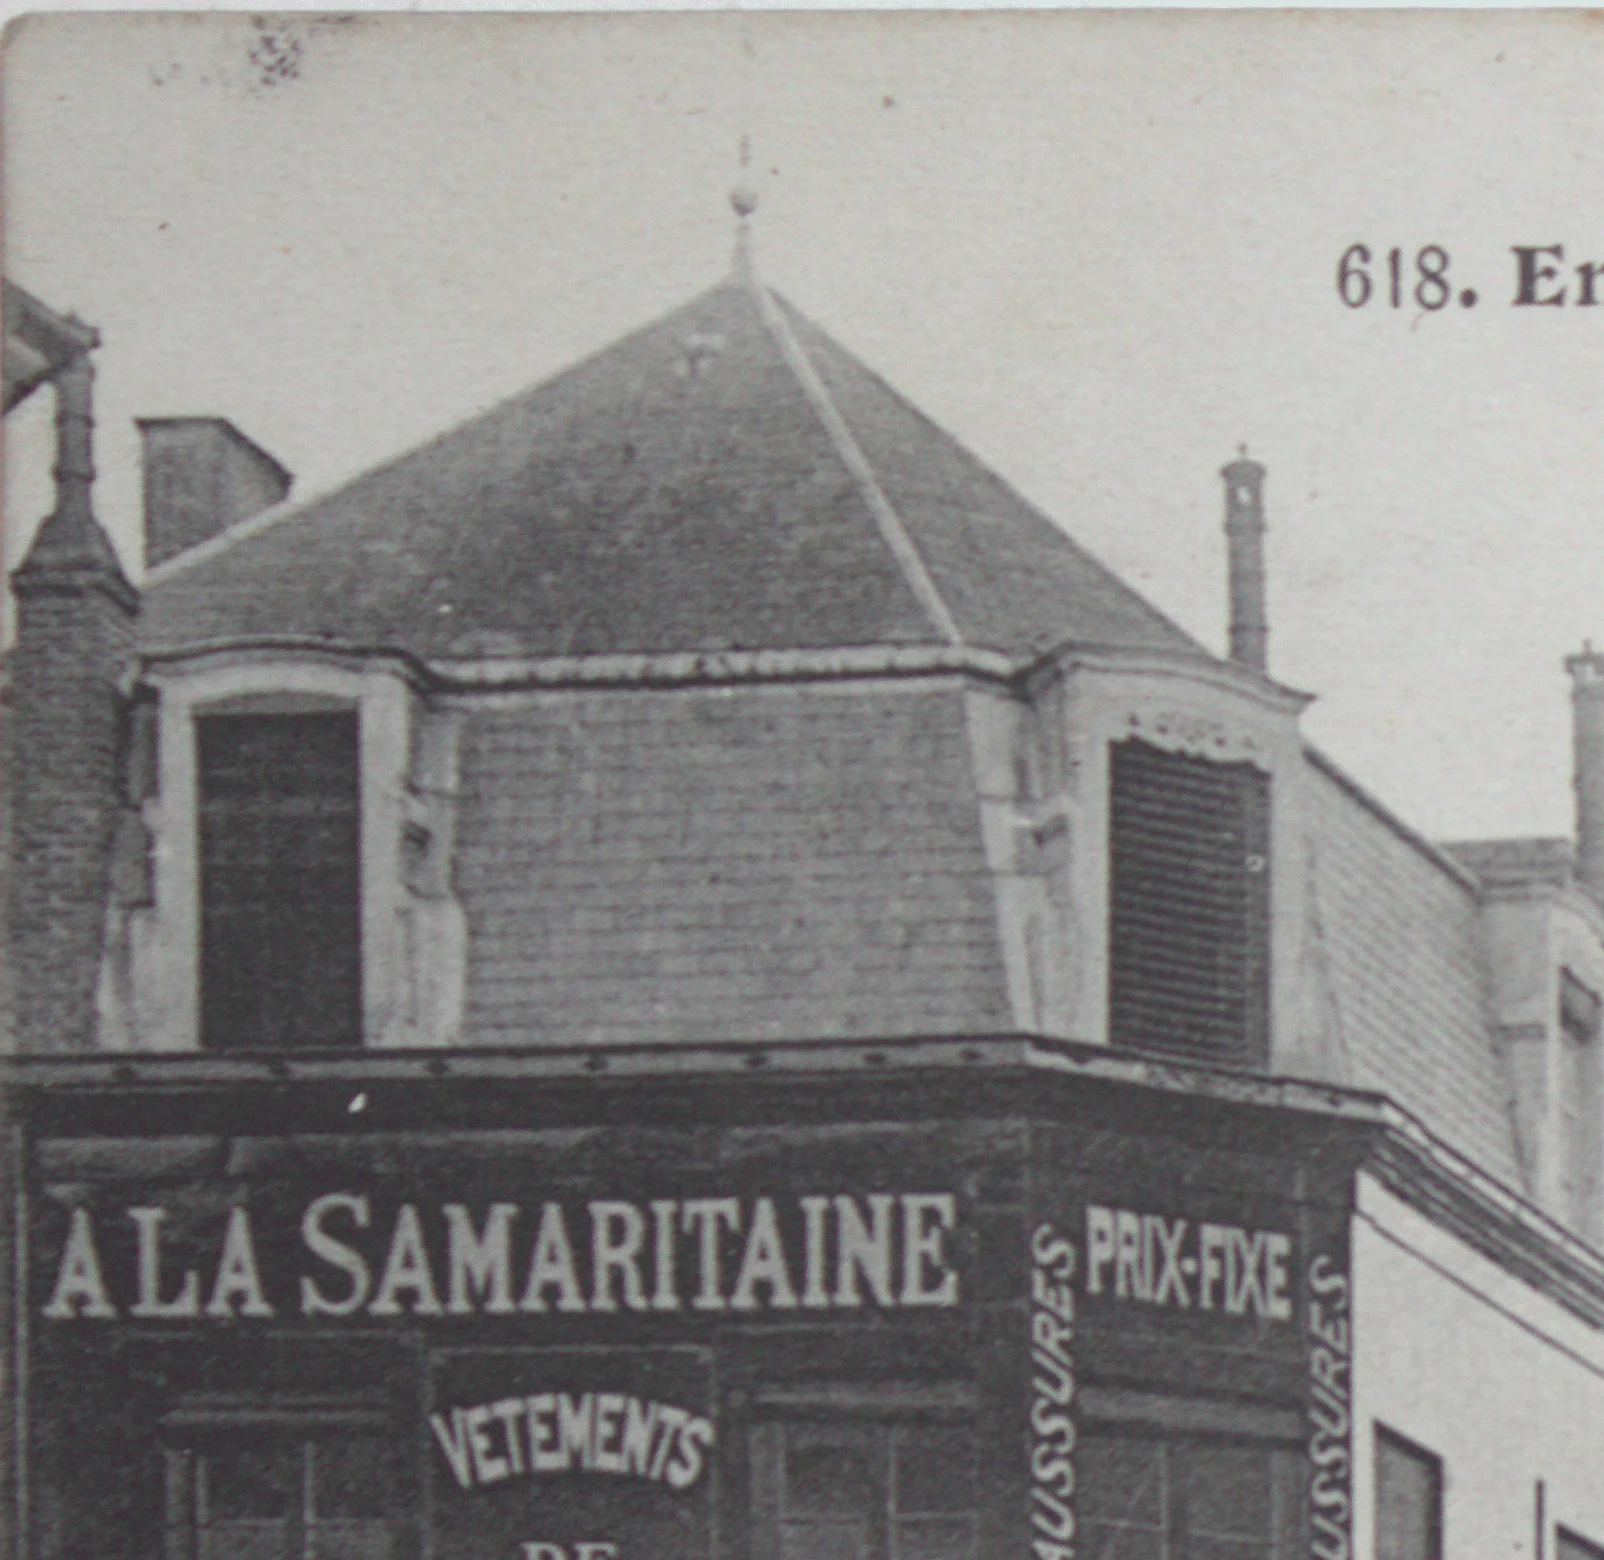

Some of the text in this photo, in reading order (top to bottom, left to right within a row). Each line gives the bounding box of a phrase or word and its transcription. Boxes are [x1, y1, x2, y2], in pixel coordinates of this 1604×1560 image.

[40, 1194, 958, 1318] A LA SAMARITAINE
[1086, 1205, 1291, 1320] PRIX-FIXE
[428, 1393, 715, 1490] VETEMENTS
